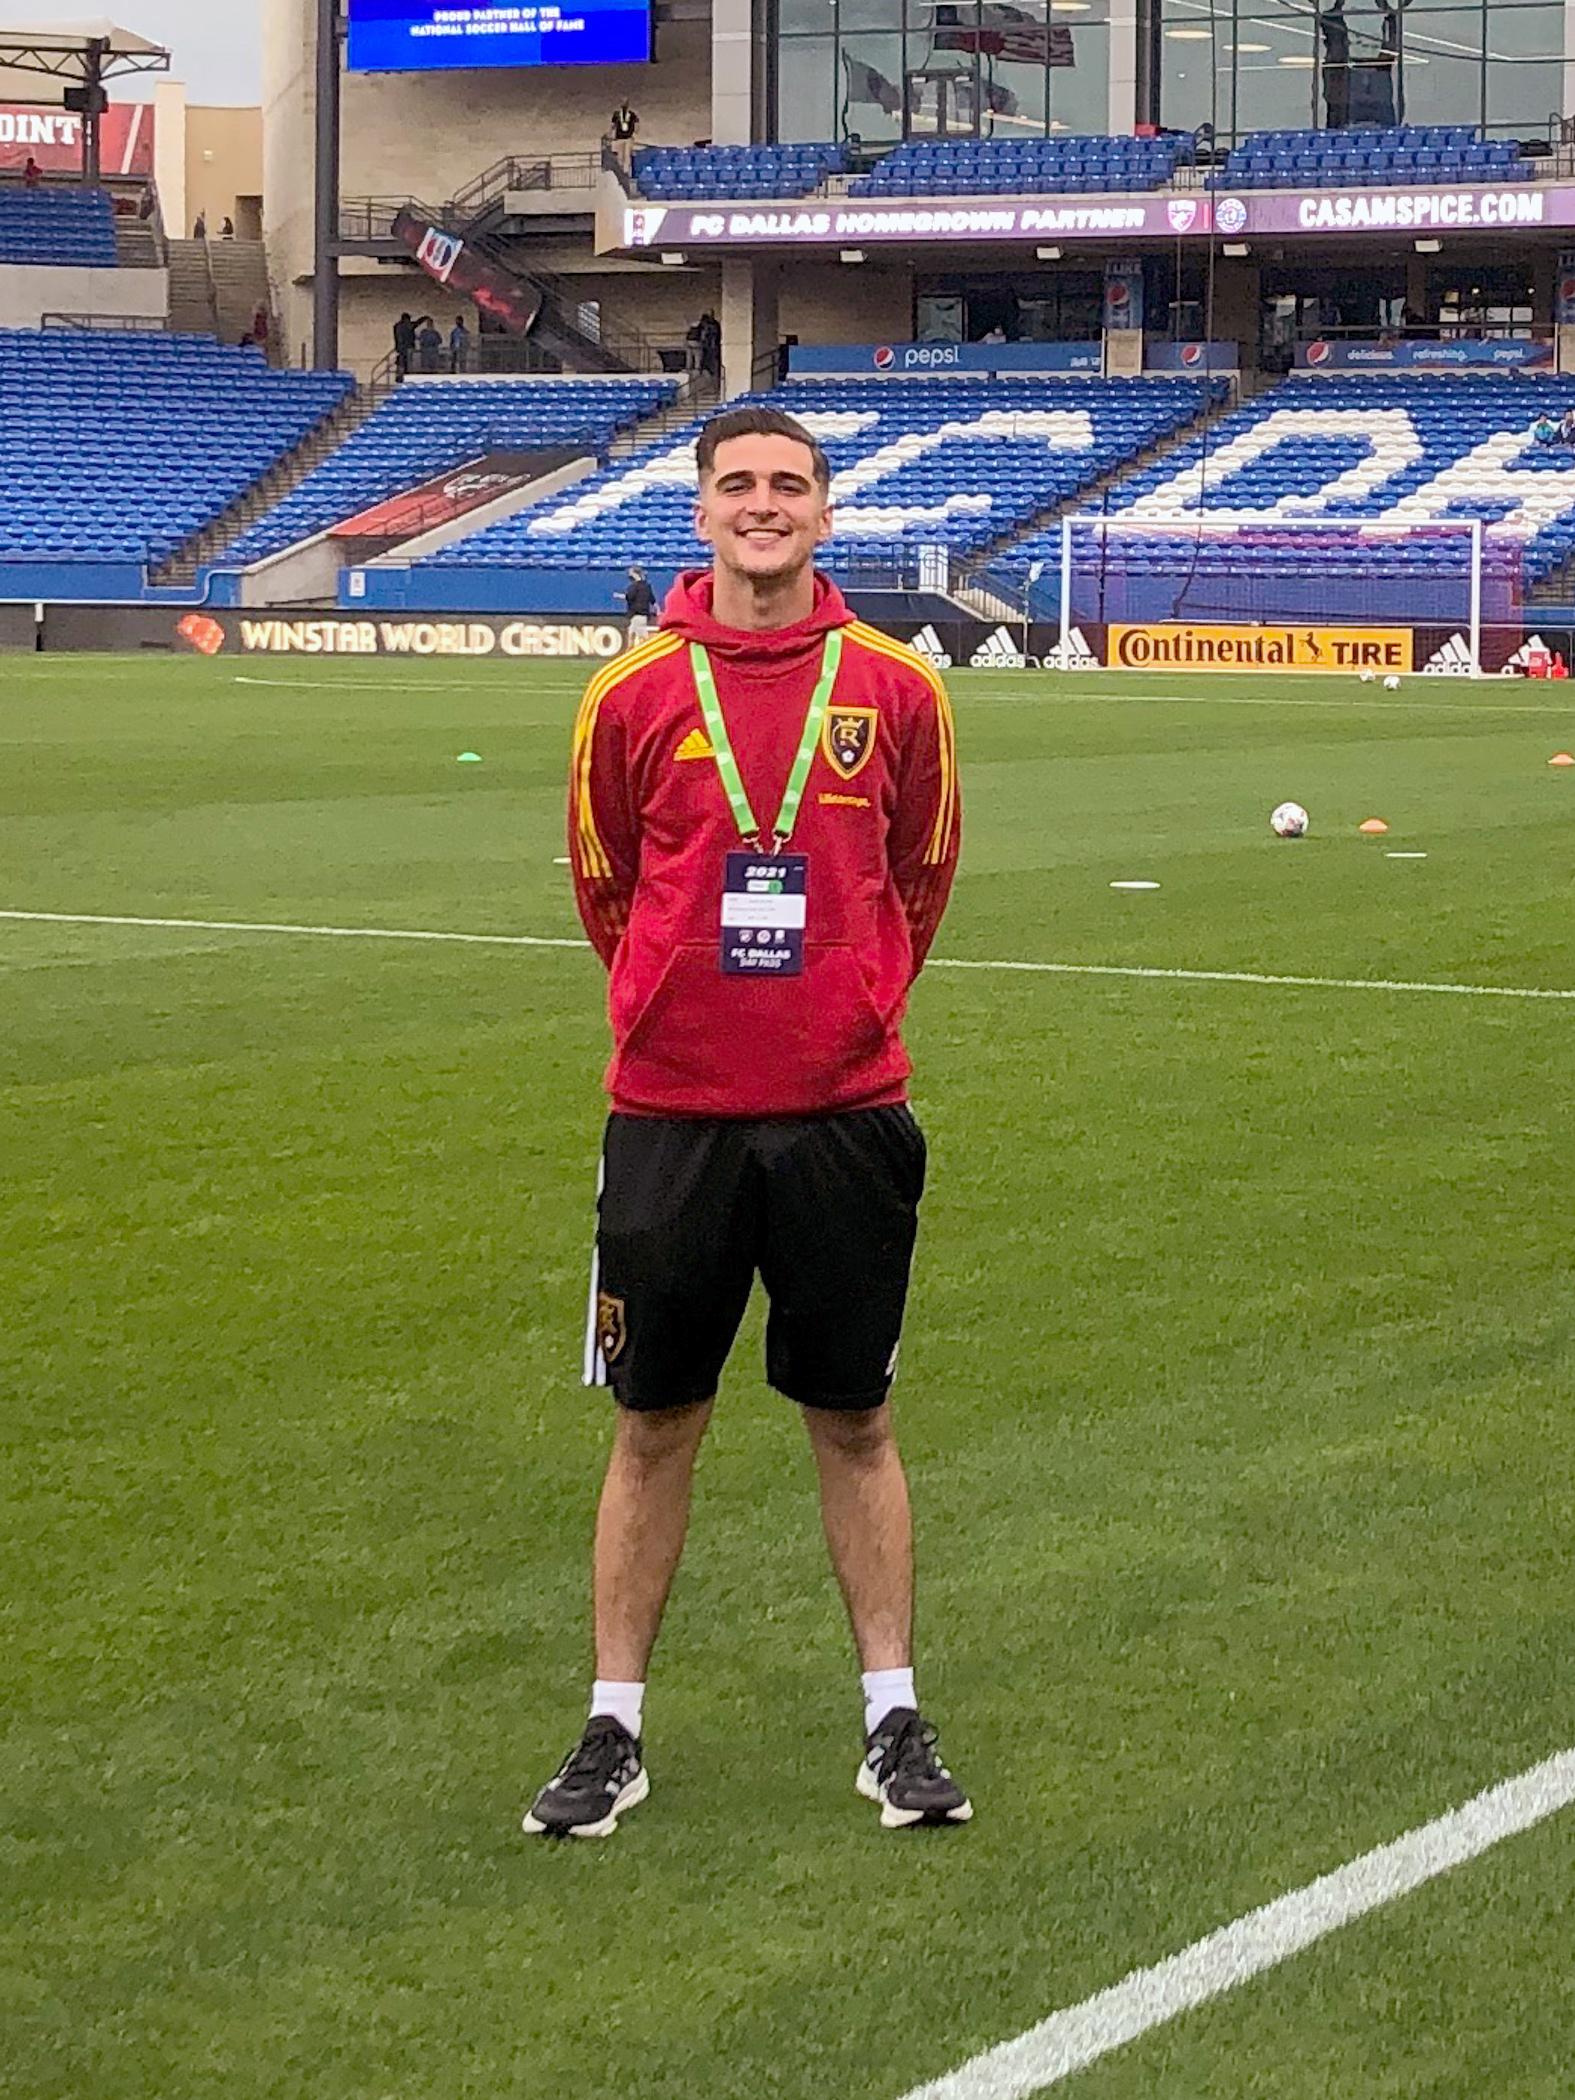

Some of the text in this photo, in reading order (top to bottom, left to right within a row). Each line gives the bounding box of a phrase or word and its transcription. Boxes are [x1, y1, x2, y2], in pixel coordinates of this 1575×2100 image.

[473, 8, 521, 21] PARTNER
[522, 7, 537, 19] OF
[539, 6, 561, 18] THE
[410, 18, 585, 37] NATIONAL SOCCER HALL OF FAME
[1299, 193, 1544, 228] CASAMSPICE.COM
[690, 214, 725, 236] FC
[729, 213, 830, 235] DALLAS
[835, 211, 1016, 234] HOMEGROWN
[1020, 208, 1146, 230] PARTNER
[904, 345, 960, 368] pepsi
[240, 620, 623, 656] WINSTAR WORLD CASINO
[1119, 628, 1403, 667] Continental TIRE
[969, 652, 1026, 668] adidas
[744, 865, 787, 879] 2021
[730, 947, 791, 960] FC DALLAS
